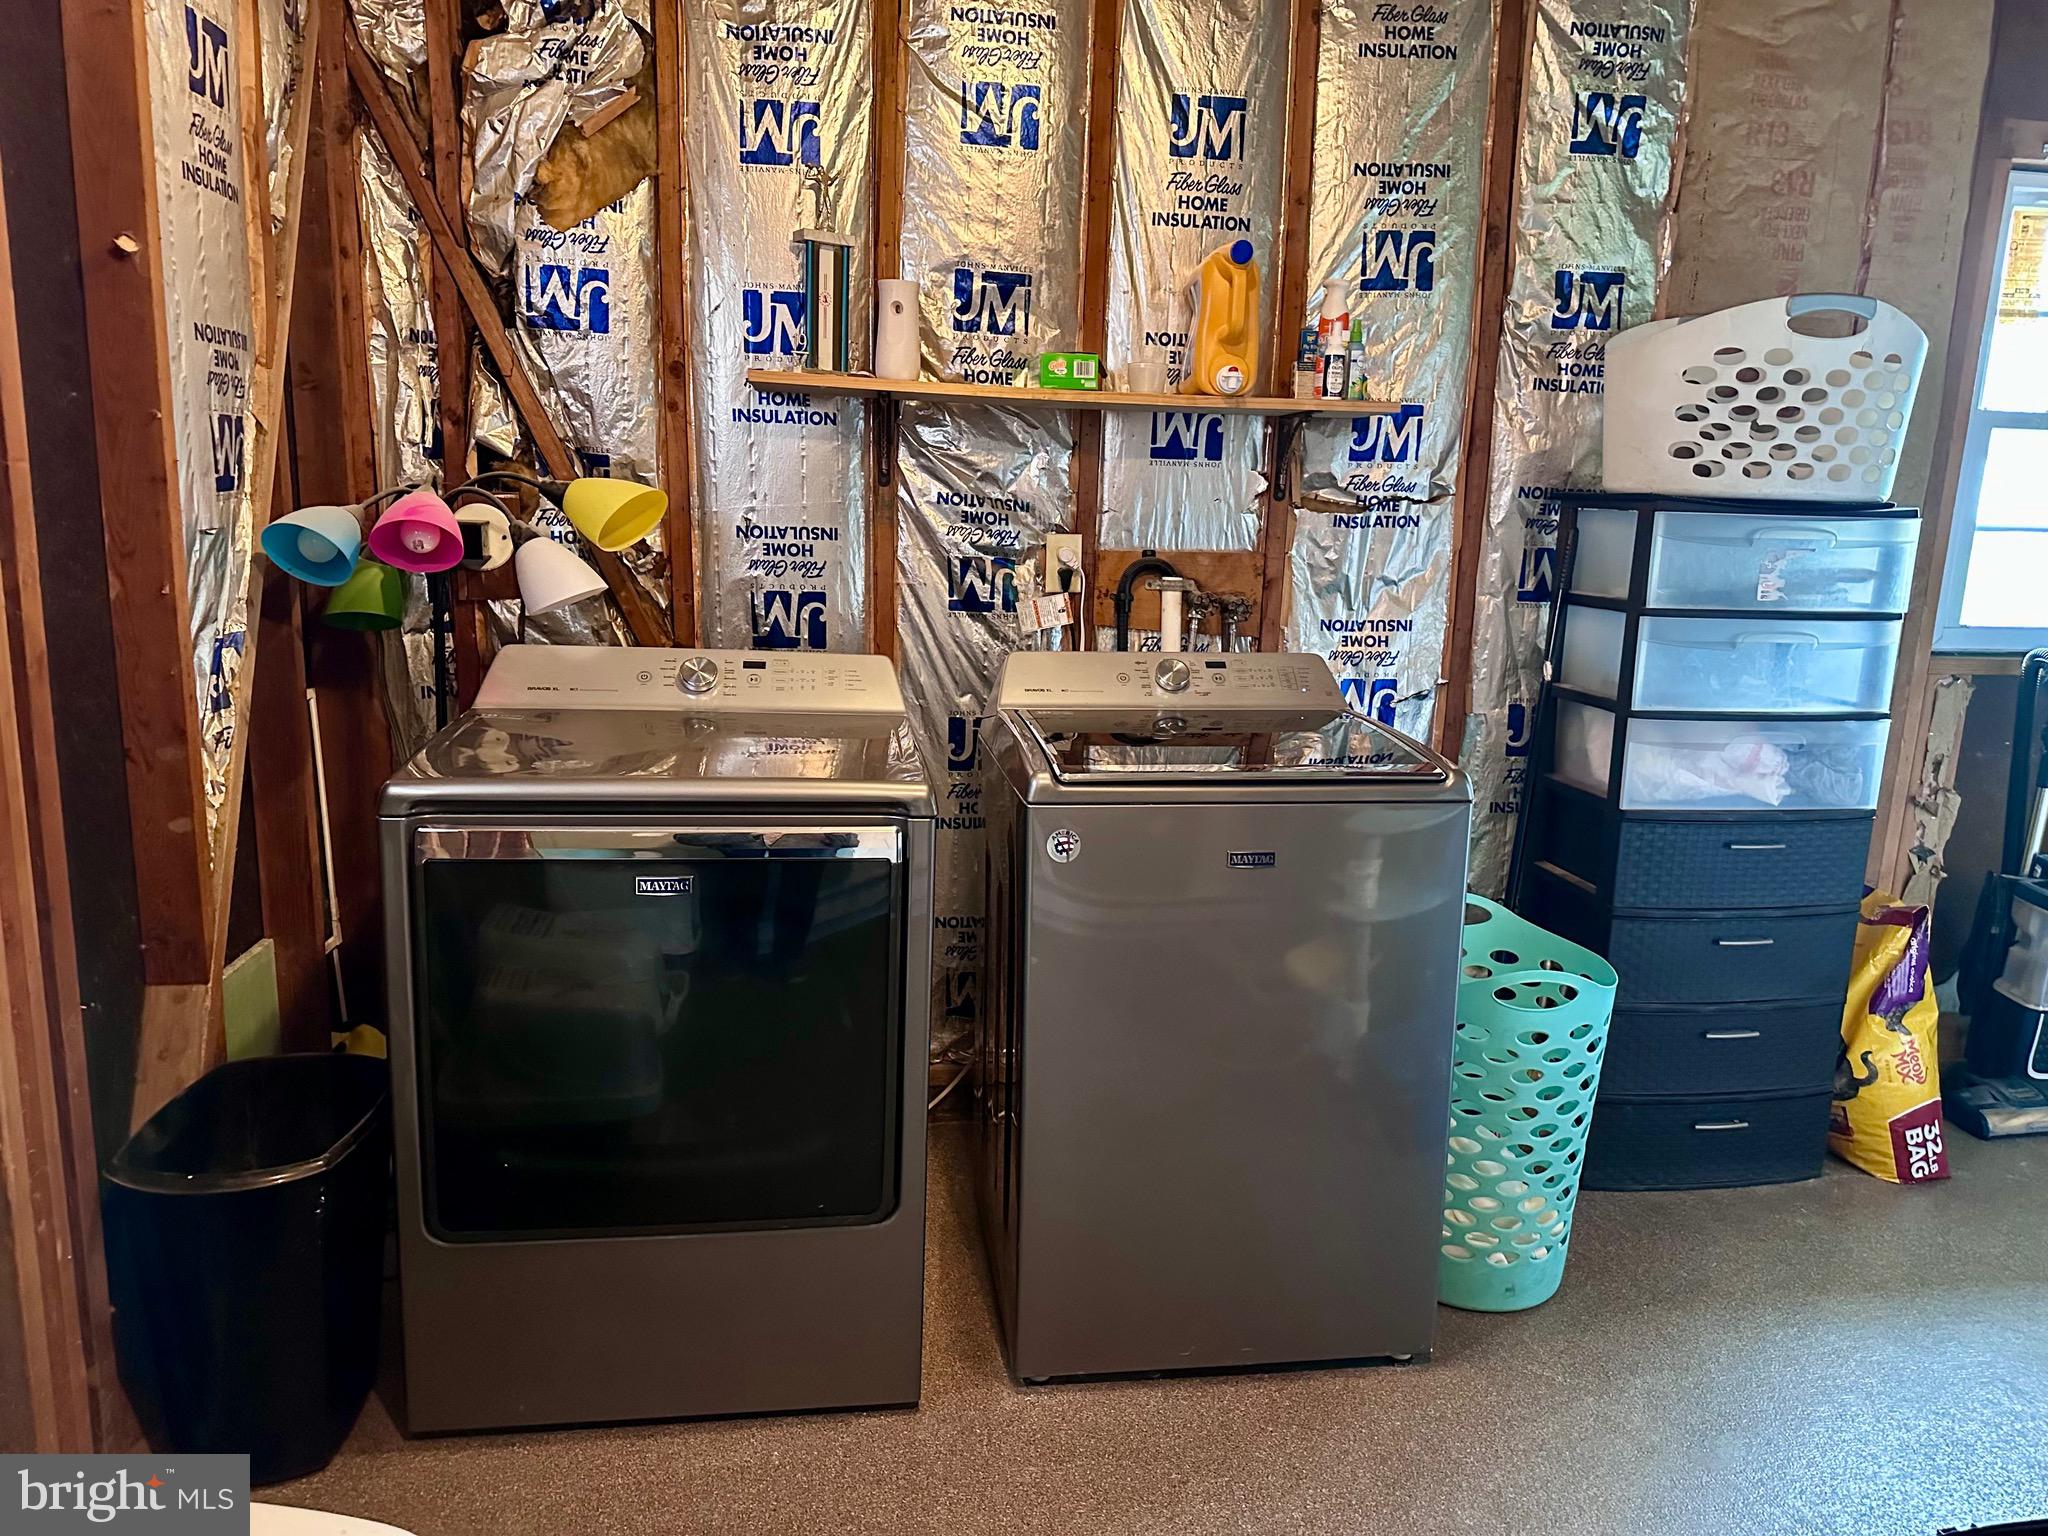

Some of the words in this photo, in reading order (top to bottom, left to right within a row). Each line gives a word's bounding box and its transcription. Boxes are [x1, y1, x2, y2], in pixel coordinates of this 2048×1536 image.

[951, 7, 1056, 30] INSULATION
[1372, 4, 1410, 22] Fiber
[1410, 5, 1449, 24] Glass
[726, 23, 834, 44] INSULATION
[977, 28, 1030, 46] HOME
[1385, 26, 1434, 41] HOME
[1570, 21, 1665, 43] INSULATION
[753, 45, 807, 61] HOME
[962, 45, 1003, 66] Glass
[1358, 43, 1458, 60] INSULATION
[1593, 41, 1643, 58] HOME
[1001, 50, 1043, 70] Fiber
[1578, 58, 1617, 79] Glass
[738, 63, 780, 84] Glass
[782, 66, 820, 86] Fiber
[1617, 62, 1651, 81] Fiber
[960, 80, 1041, 151] JM
[1569, 91, 1647, 158] JM
[189, 112, 213, 144] Fiber
[212, 125, 233, 157] Glass
[740, 99, 821, 166] JM
[1169, 93, 1247, 161] JM
[198, 144, 228, 175] HOME
[1169, 158, 1244, 170] PRODUCTS
[1354, 162, 1450, 178] INSULATION
[182, 160, 239, 205] INSULATION
[1166, 171, 1203, 191] Fiber
[1204, 174, 1243, 195] Glass
[1379, 180, 1426, 195] HOME
[1178, 195, 1228, 212] HOME
[1364, 197, 1402, 216] Glass
[1402, 198, 1439, 217] Fiber
[1152, 212, 1251, 232] INSULATION
[525, 228, 569, 250] Glass
[569, 234, 610, 254] Fiber
[1360, 230, 1435, 291] JM
[525, 264, 610, 334] JM
[951, 268, 1032, 337] JM
[1551, 270, 1625, 330] JM
[953, 333, 1029, 345] PRODUCTS
[951, 346, 988, 367] Fiber
[989, 348, 1028, 370] Glass
[1546, 342, 1583, 359] Fiber
[1583, 343, 1605, 360] Gla
[964, 369, 1013, 386] HOME
[1533, 378, 1605, 394] INSULATI
[758, 390, 811, 408] HOME
[732, 408, 837, 426] INSULATION
[1347, 462, 1418, 470] PRODUCTS
[1344, 474, 1381, 493] Fiber
[1381, 475, 1417, 494] Glass
[936, 491, 1031, 513] INSULATION
[961, 511, 1009, 526] HOME
[1332, 514, 1420, 530] INSULATION
[736, 524, 839, 541] INSULATION
[945, 525, 985, 544] Glass
[986, 530, 1021, 548] Fiber
[762, 542, 814, 558] HOME
[748, 559, 789, 579] Glass
[790, 561, 827, 578] Fiber
[749, 582, 827, 590] PRODUCTS
[750, 590, 827, 649] JM
[1320, 619, 1412, 632] INSULATION
[1341, 635, 1389, 648] HOME
[1327, 650, 1365, 667] Glass
[1364, 651, 1400, 667] Fiber
[1051, 830, 1079, 844] AMERICA
[1230, 855, 1274, 864] MAYTAG
[639, 881, 689, 891] MAYTAG
[1905, 1126, 1930, 1179] BAG
